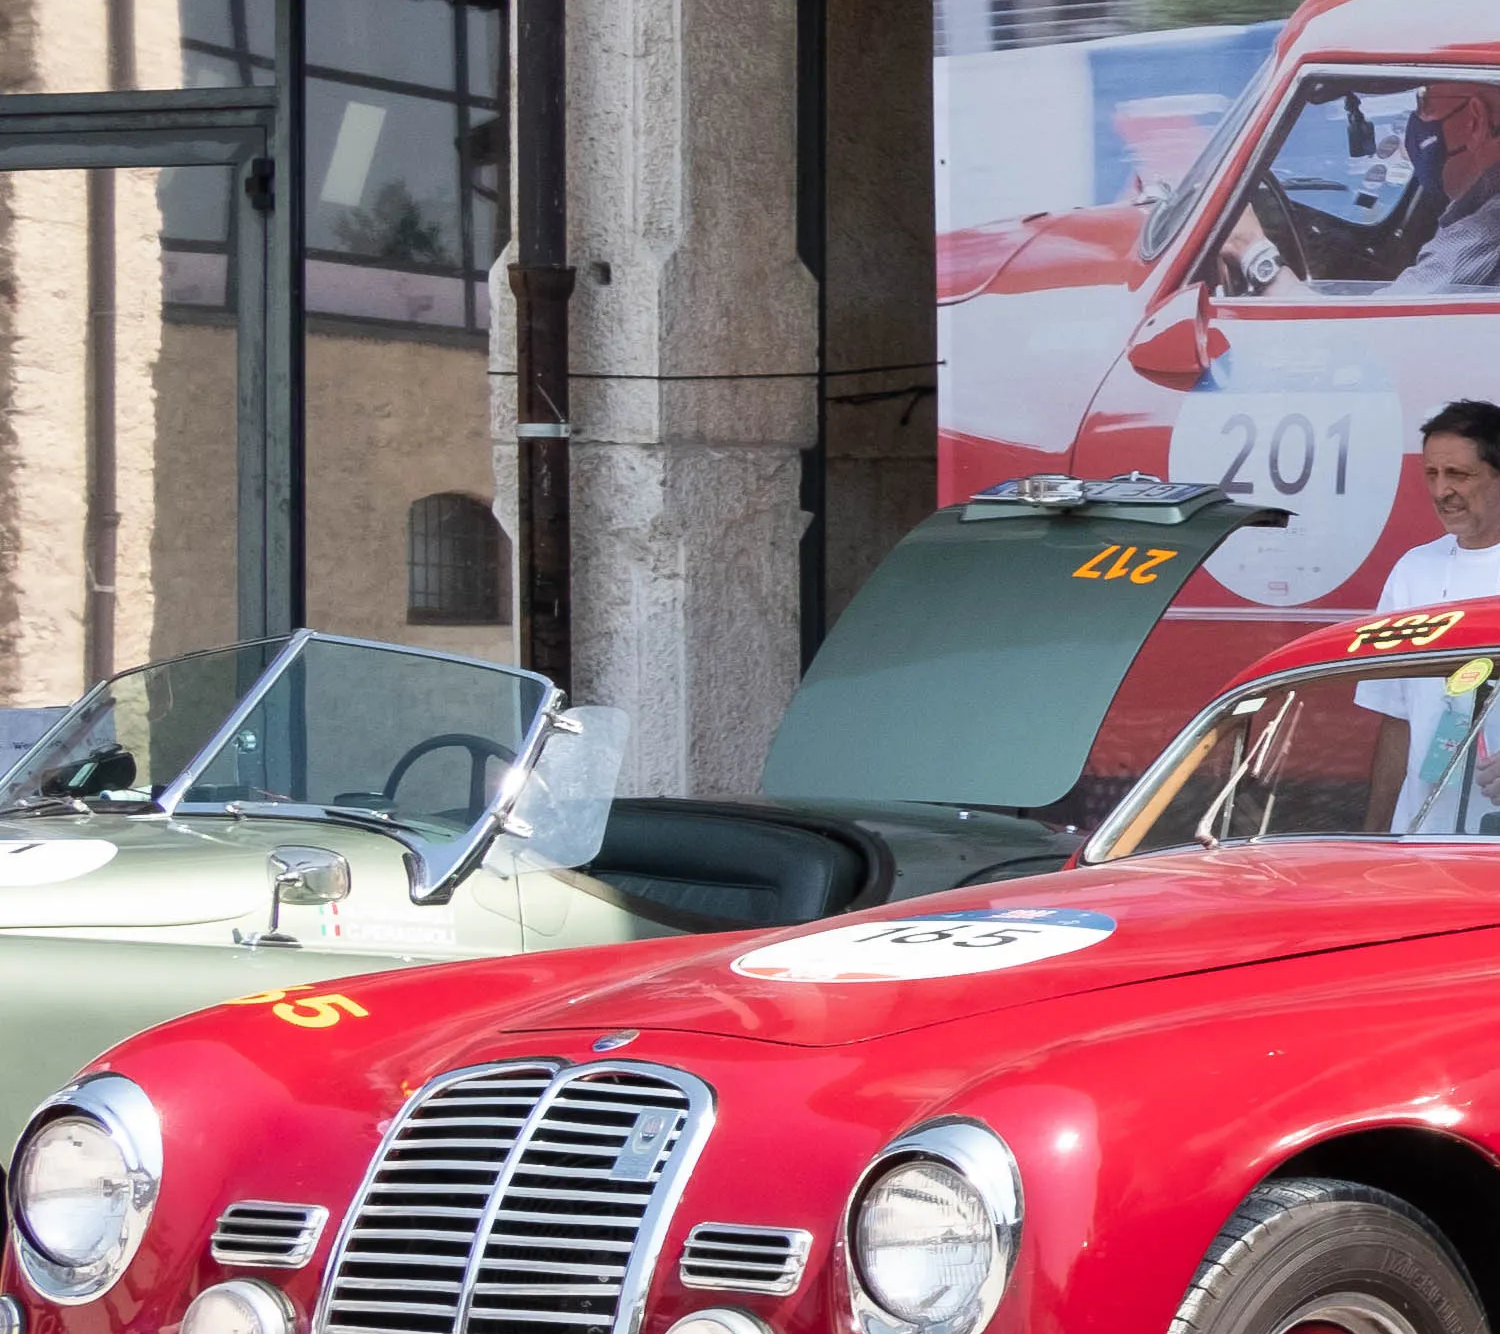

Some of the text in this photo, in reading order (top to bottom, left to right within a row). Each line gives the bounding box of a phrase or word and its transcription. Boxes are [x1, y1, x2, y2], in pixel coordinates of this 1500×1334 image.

[1220, 414, 1352, 495] 201
[1072, 545, 1177, 584] 217
[854, 924, 1042, 948] 165
